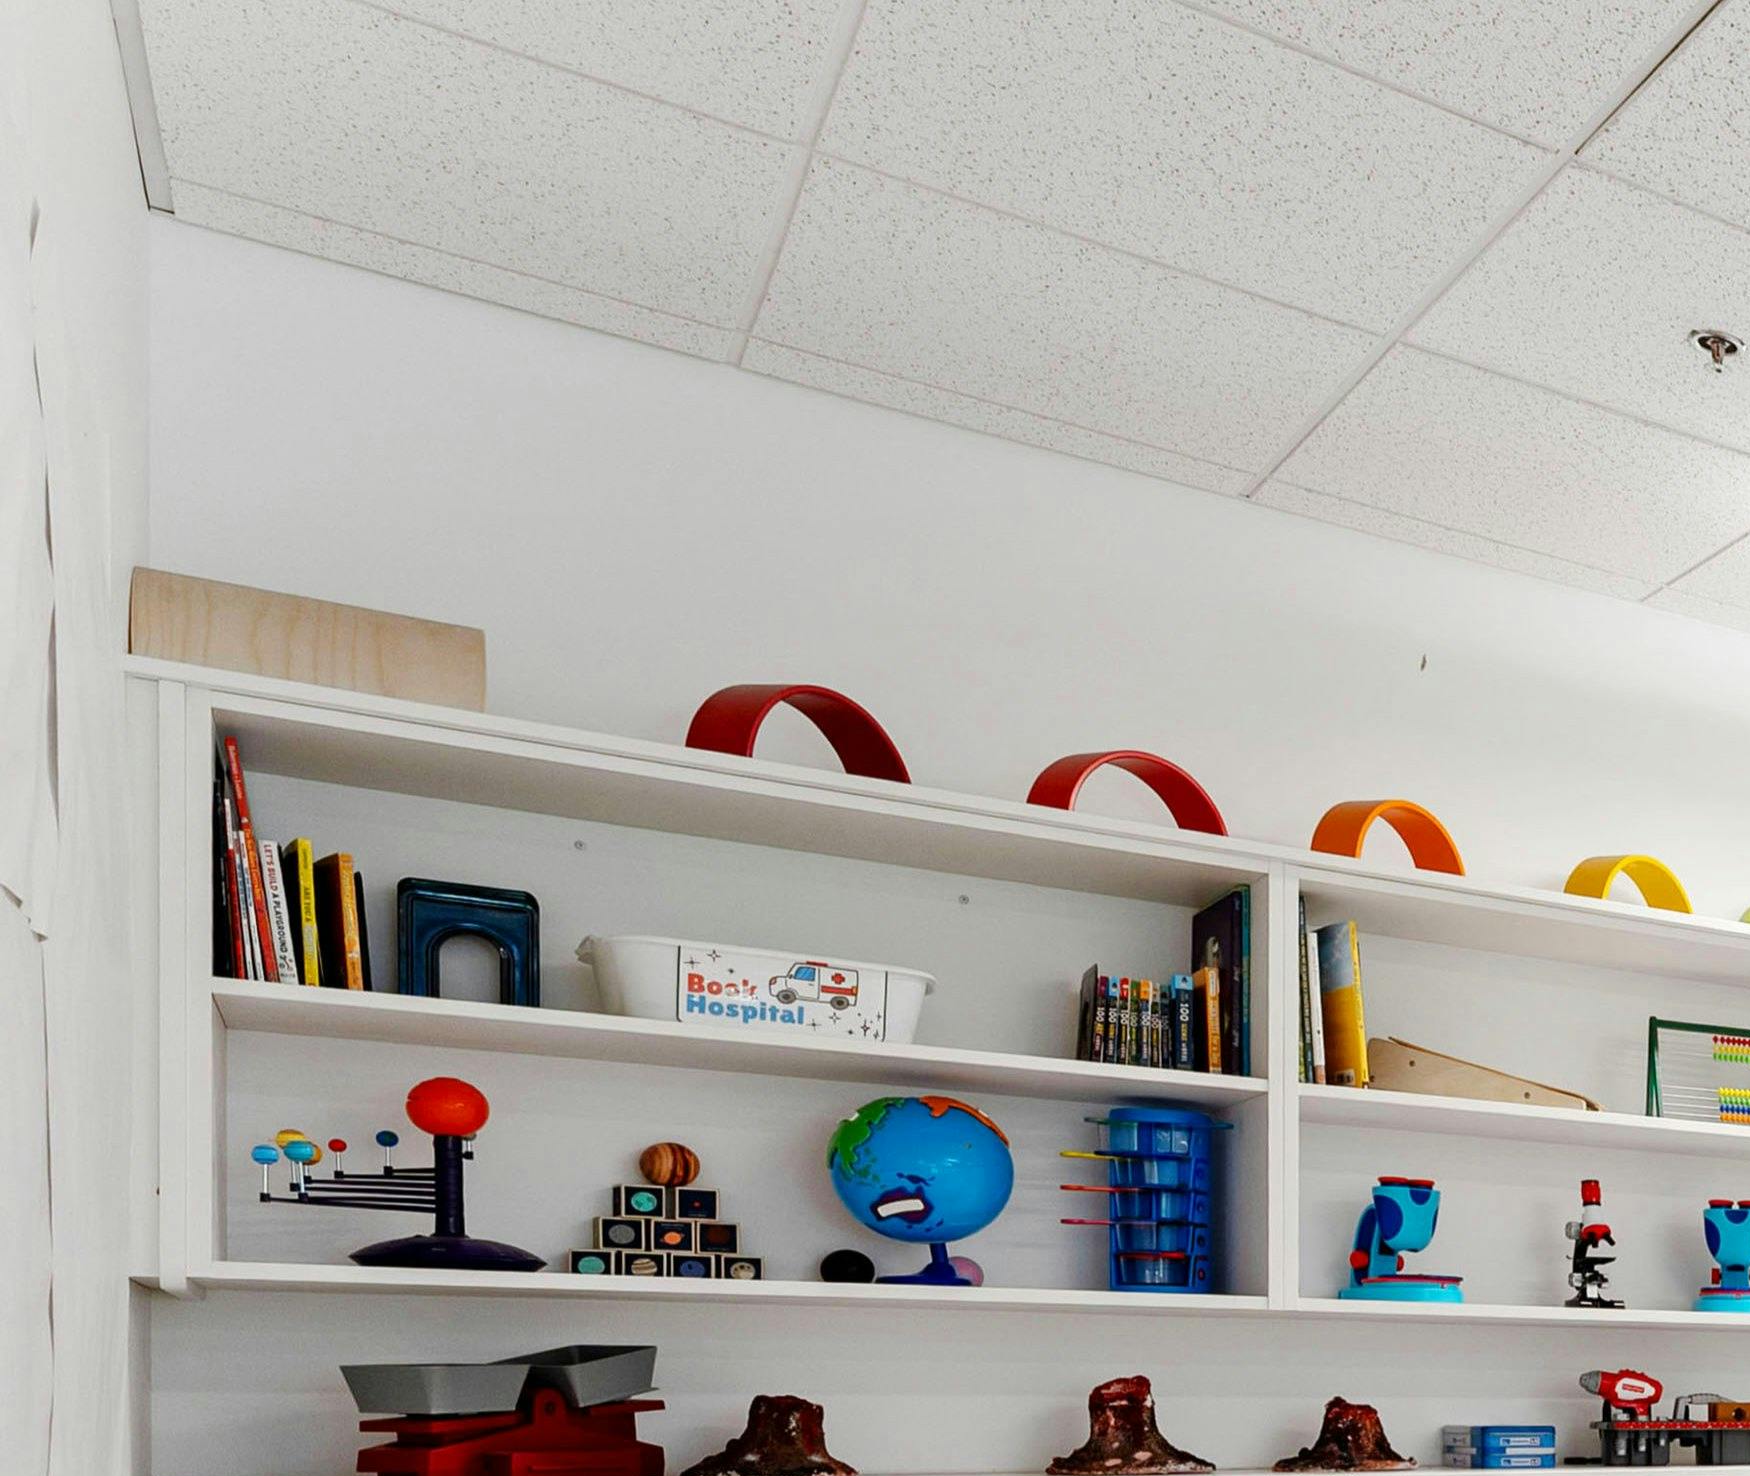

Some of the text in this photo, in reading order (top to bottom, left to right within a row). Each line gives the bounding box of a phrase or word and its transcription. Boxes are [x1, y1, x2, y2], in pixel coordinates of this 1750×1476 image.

[263, 844, 276, 866] LET'S
[267, 868, 279, 892] BUILD
[274, 900, 289, 953] PLAYGROUND
[686, 994, 805, 1025] Hospital
[1097, 1007, 1106, 1022] 100
[1108, 1007, 1117, 1023] 100
[1120, 1009, 1129, 1025] 100
[1180, 1003, 1190, 1022] 100
[1142, 1011, 1150, 1026] 100
[1151, 1013, 1159, 1028] 100
